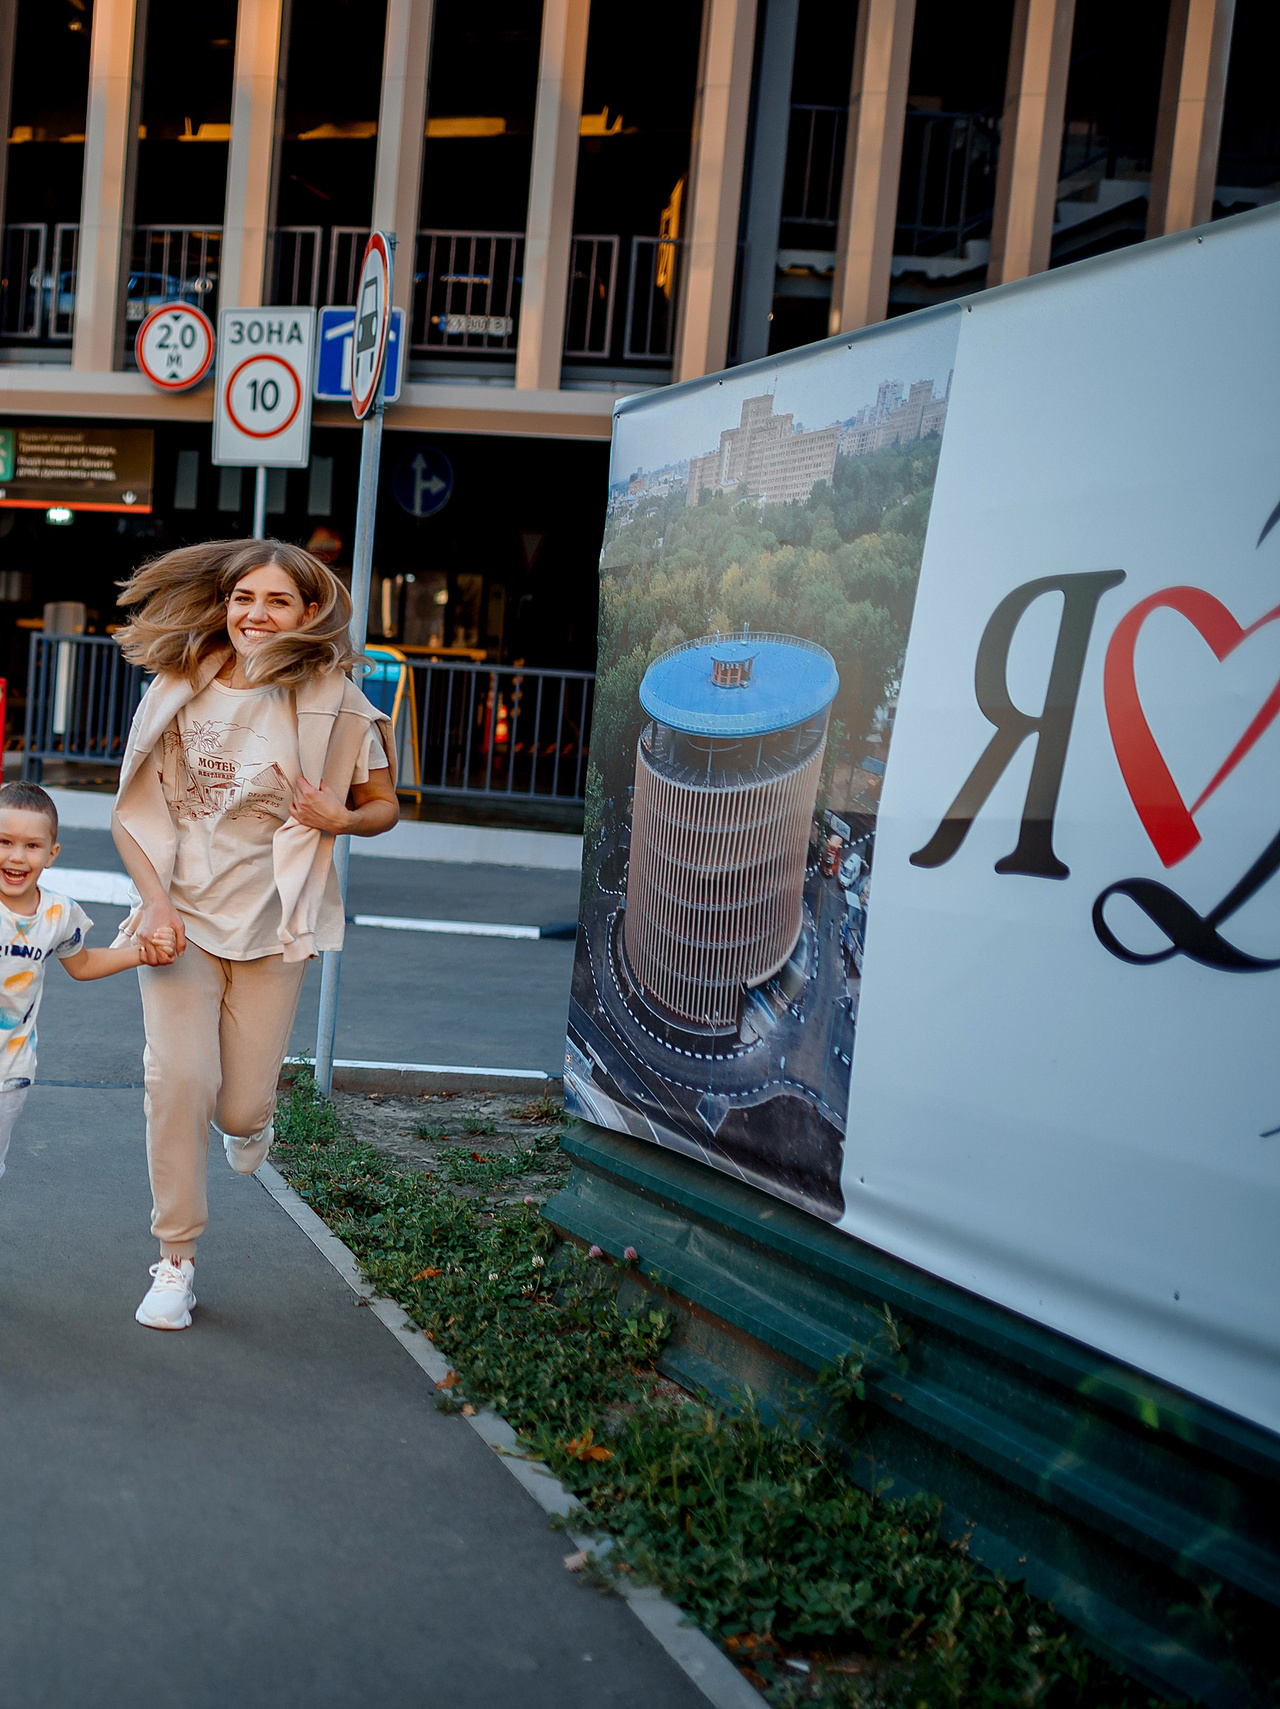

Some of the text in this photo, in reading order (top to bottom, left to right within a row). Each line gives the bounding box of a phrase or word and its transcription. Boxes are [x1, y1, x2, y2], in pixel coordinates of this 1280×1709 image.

[230, 321, 303, 344] ЗОНА
[248, 378, 279, 412] 10
[909, 568, 1127, 881] Я
[198, 757, 236, 772] MOTEL
